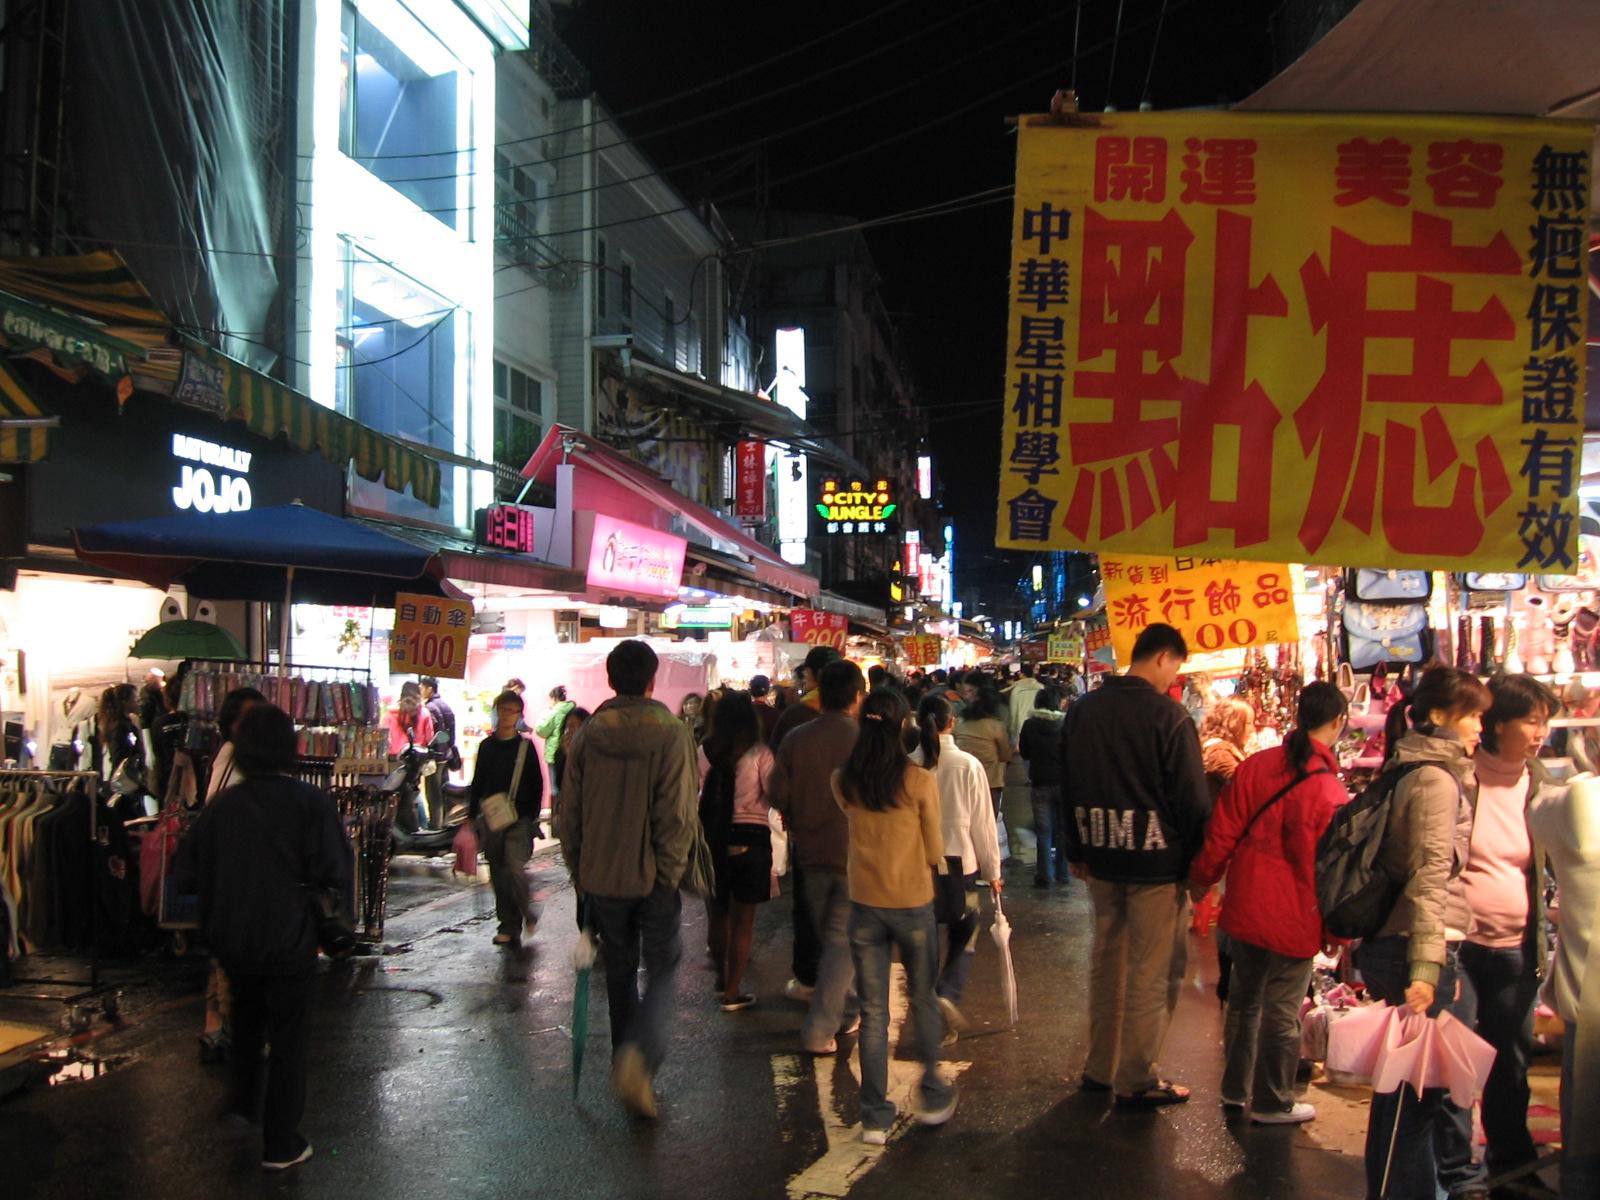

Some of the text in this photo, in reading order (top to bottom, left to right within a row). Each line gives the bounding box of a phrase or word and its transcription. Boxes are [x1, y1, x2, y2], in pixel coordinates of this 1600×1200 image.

[1093, 136, 1505, 209] 開運 美容
[1007, 201, 1071, 542] 中華星相學會
[1515, 145, 1588, 572] 無疤保證有效
[1062, 205, 1523, 557] 點痣
[173, 433, 252, 473] NATURALLY
[173, 466, 252, 513] JOJO
[834, 492, 877, 505] CITY
[828, 505, 883, 520] JUNGLE
[1103, 561, 1169, 585] 新貨到
[400, 603, 467, 628] 自動傘
[1113, 573, 1289, 629] 流行飾品
[409, 630, 455, 670] 100
